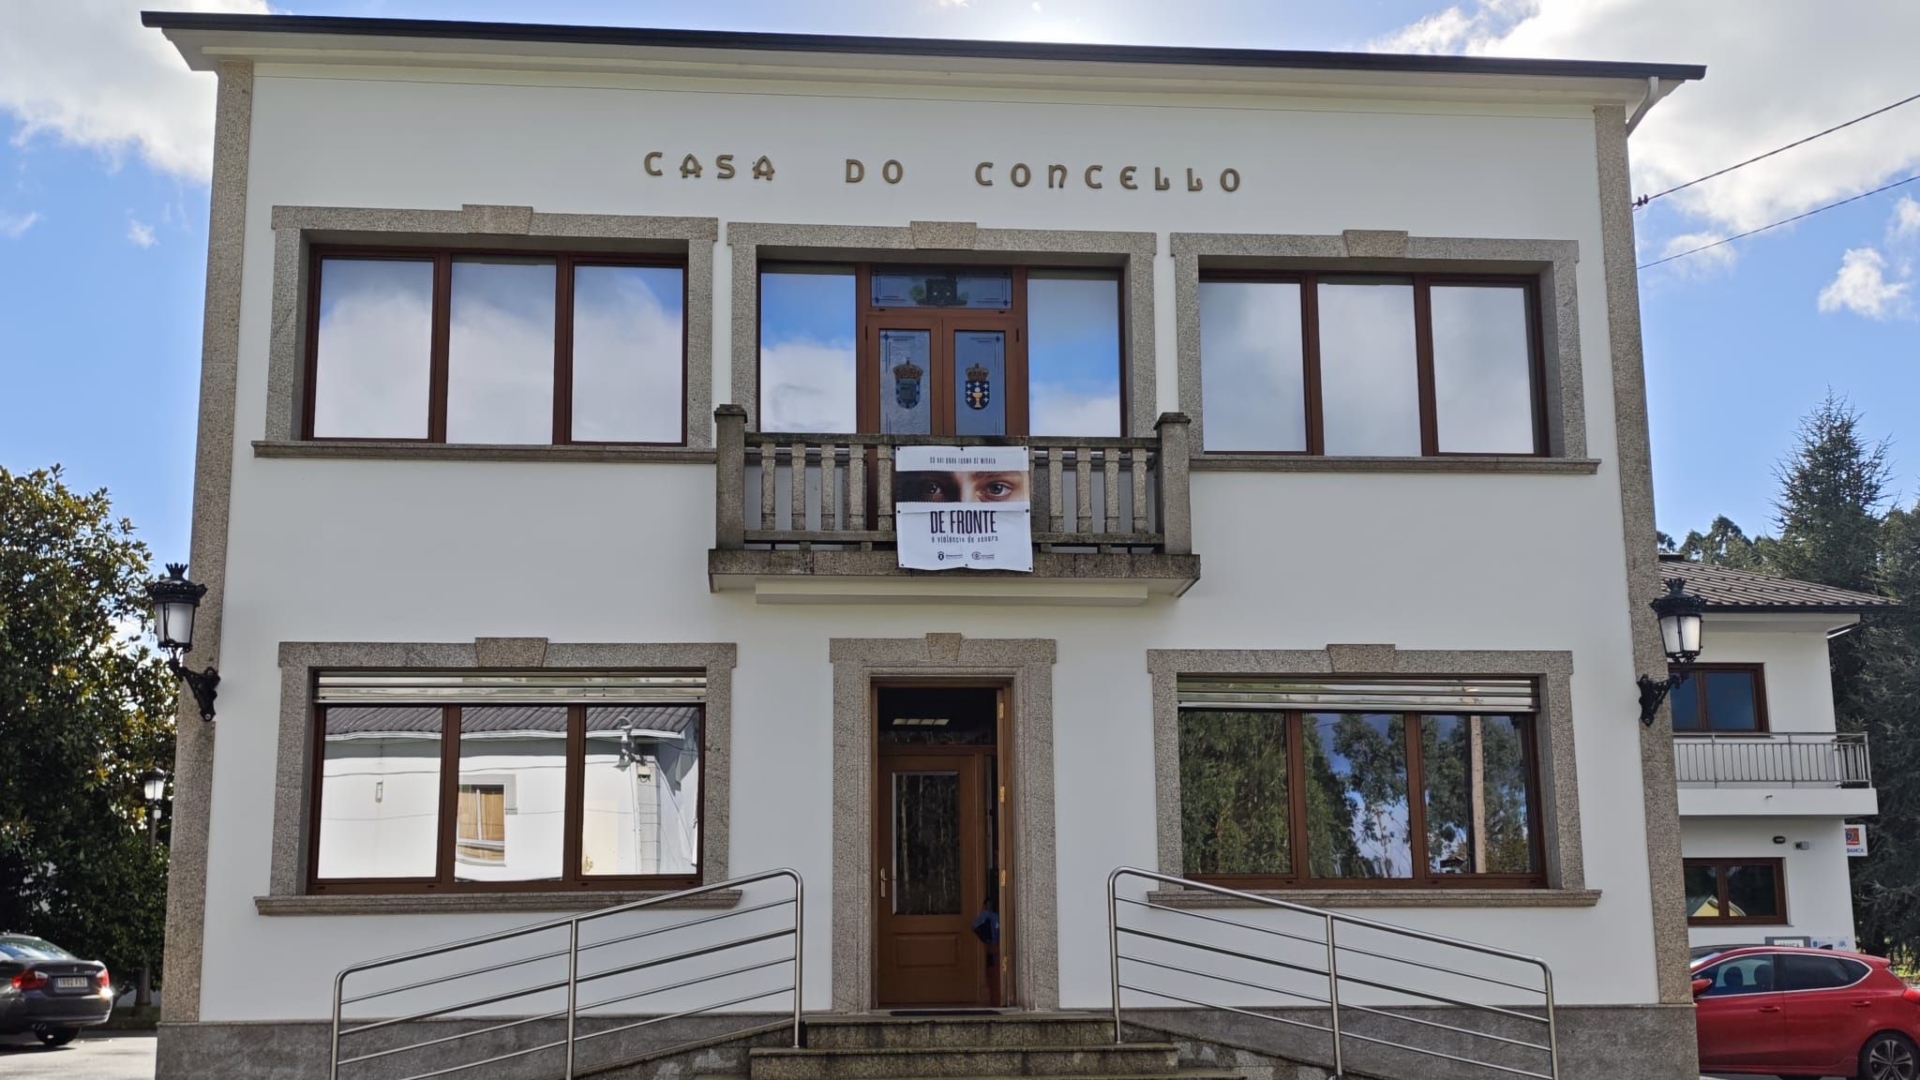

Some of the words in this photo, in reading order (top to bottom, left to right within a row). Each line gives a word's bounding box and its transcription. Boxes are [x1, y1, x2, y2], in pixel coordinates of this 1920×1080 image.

[643, 151, 776, 182] CASA
[845, 158, 904, 185] DO
[974, 161, 1241, 193] CONCELLO
[930, 510, 946, 534] DE
[950, 510, 998, 534] FRONTE
